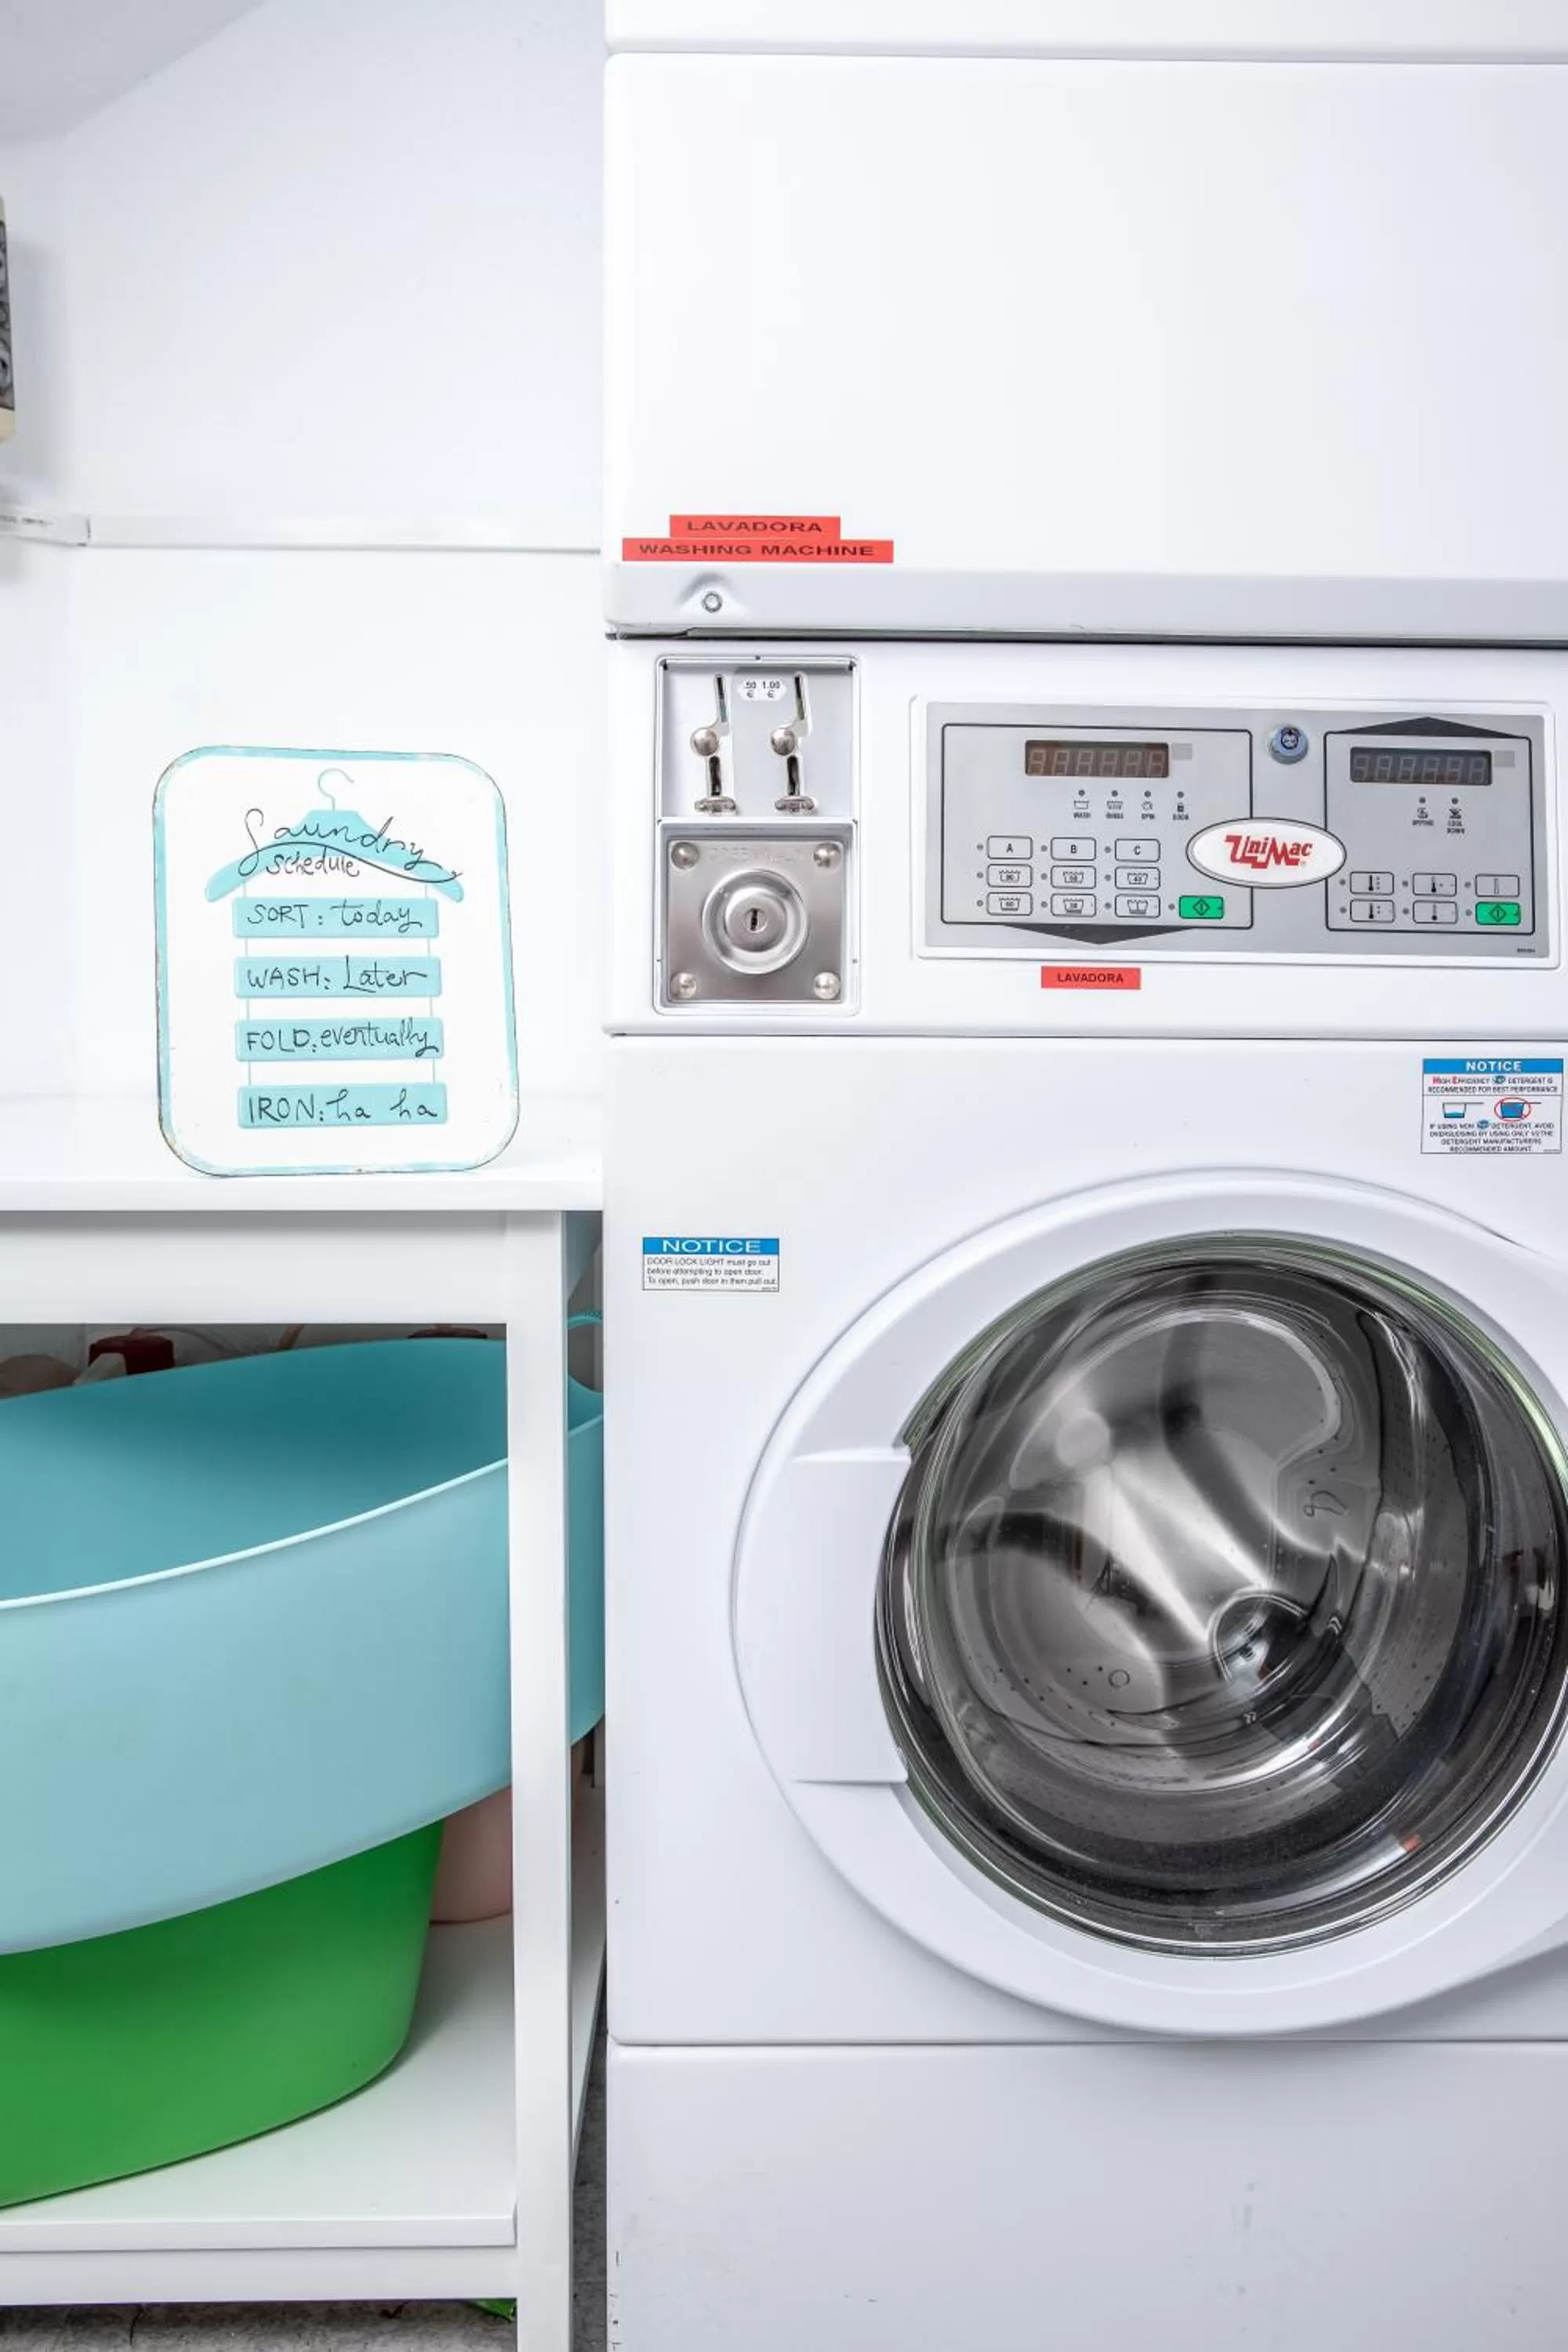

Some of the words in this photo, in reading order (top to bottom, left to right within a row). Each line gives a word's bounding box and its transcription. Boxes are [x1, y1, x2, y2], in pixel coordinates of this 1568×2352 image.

[687, 521, 823, 533] LAVADORA
[639, 543, 753, 556] WASHING
[760, 544, 875, 557] MACHINE
[1006, 843, 1014, 854] A
[1070, 844, 1078, 855] B
[1133, 845, 1142, 856] C
[1224, 834, 1314, 869] UniMac
[330, 900, 423, 932] today
[343, 954, 428, 993] Later
[1057, 971, 1124, 983] LAVADORA
[319, 1017, 439, 1058] eventually
[1465, 1061, 1523, 1072] NOTICE
[326, 1087, 372, 1120] ha
[389, 1089, 439, 1118] ha
[662, 1240, 761, 1254] NOTICE
[647, 1257, 672, 1265] DOOR
[674, 1257, 697, 1266] LOCK
[699, 1257, 724, 1266] LIGHT
